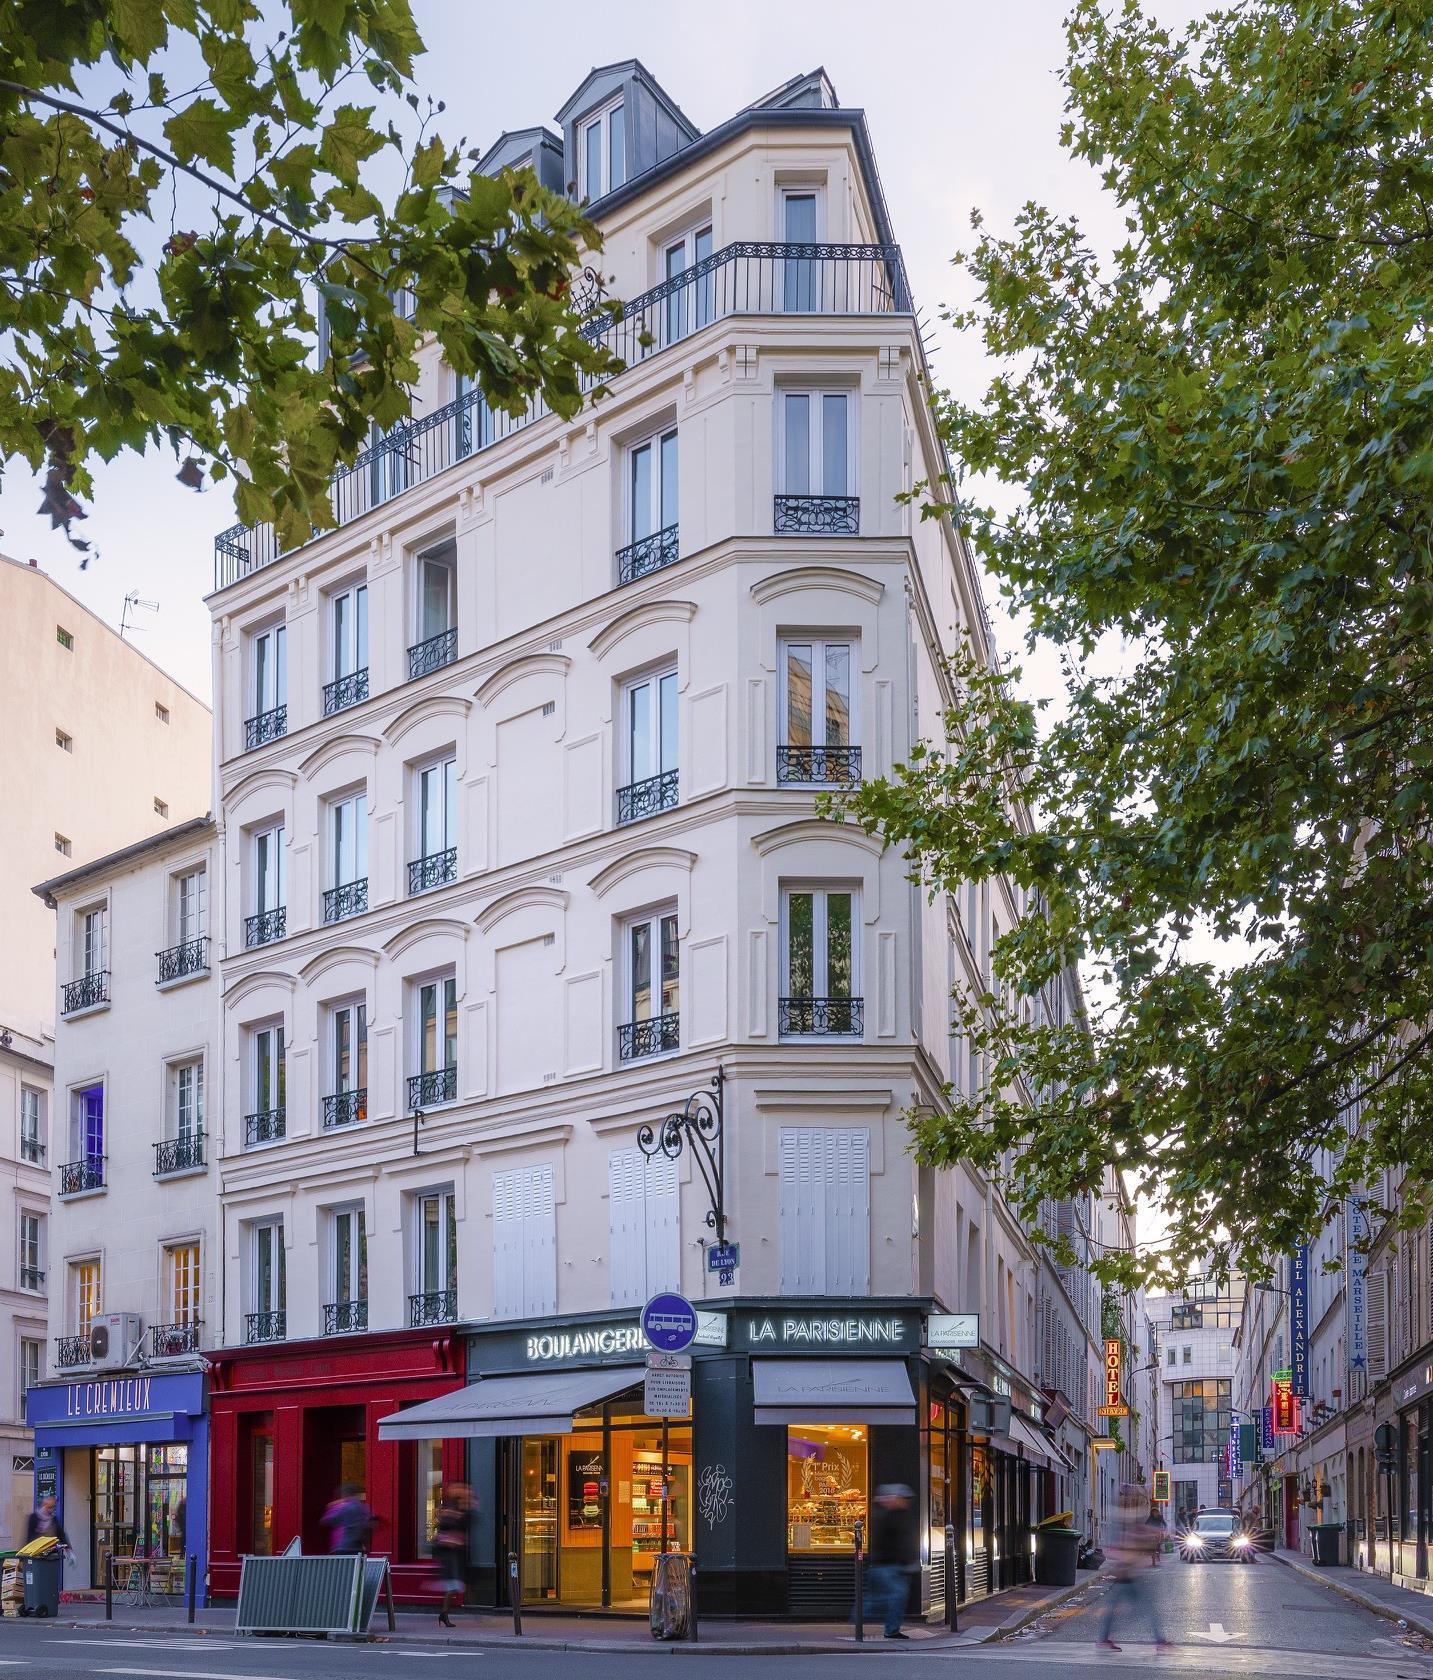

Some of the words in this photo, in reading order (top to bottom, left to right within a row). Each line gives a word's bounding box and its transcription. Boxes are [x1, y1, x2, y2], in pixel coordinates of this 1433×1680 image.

[720, 1258, 735, 1266] LYON
[1352, 1269, 1363, 1350] MARSEILLE
[750, 1319, 776, 1342] LA
[783, 1319, 904, 1342] PARISIENNE
[1295, 1288, 1304, 1396] ALEXANDRIE
[778, 1385, 799, 1393] LA
[802, 1385, 890, 1393] PARISIENNE
[1107, 1342, 1119, 1407] HOTEL
[68, 1384, 81, 1416] LE
[86, 1377, 152, 1415] CREMIEUX
[822, 1462, 840, 1471] Prix
